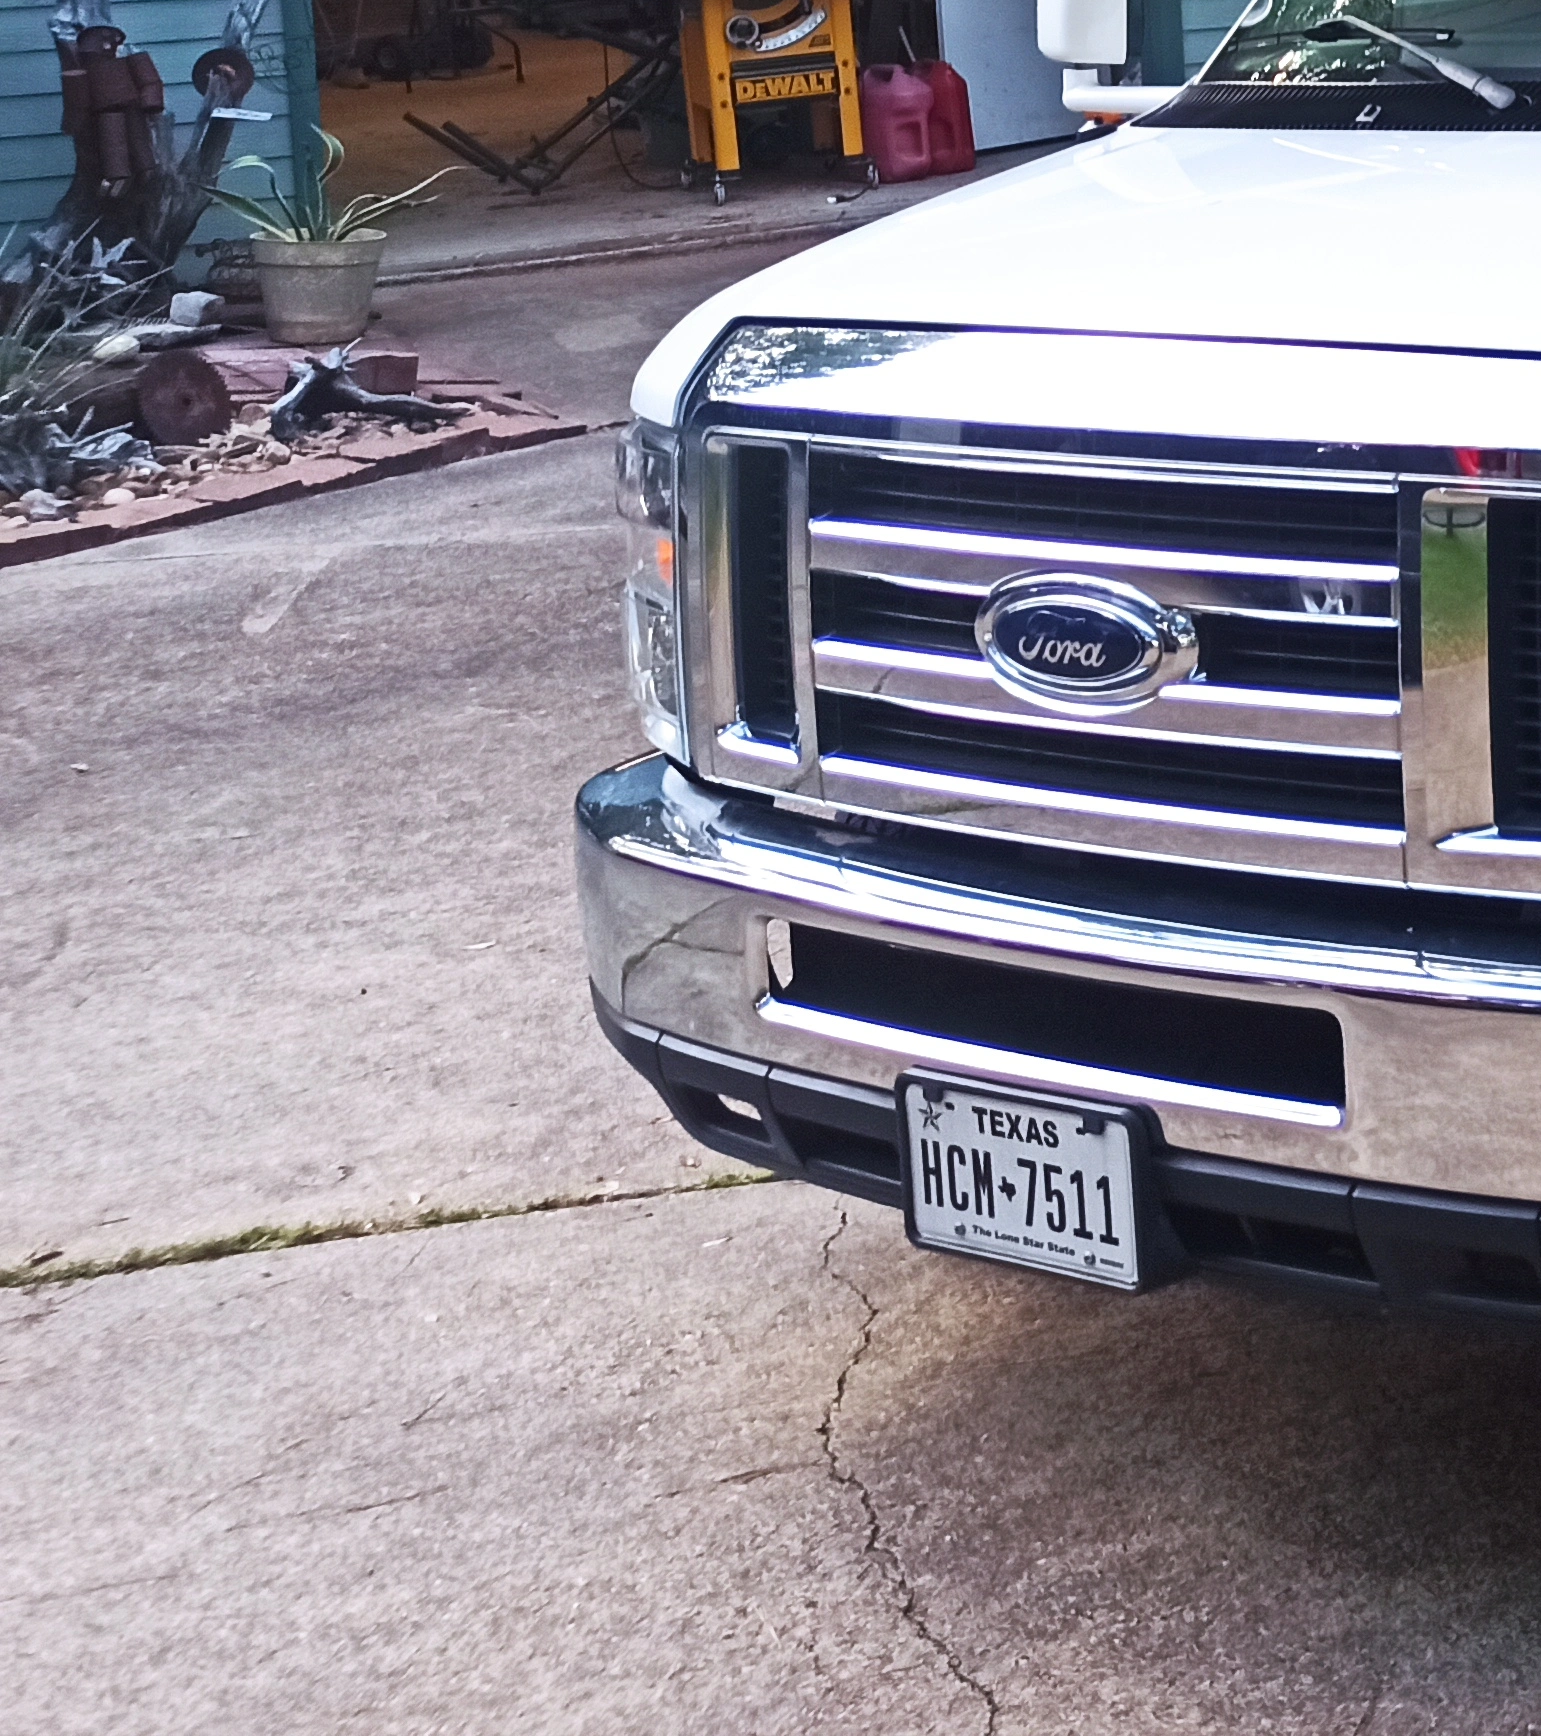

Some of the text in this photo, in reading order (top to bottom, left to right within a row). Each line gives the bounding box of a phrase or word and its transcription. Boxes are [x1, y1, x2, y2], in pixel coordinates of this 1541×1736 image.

[971, 1105, 1060, 1149] TEXAS
[972, 1224, 1076, 1256] The Lone Star State
